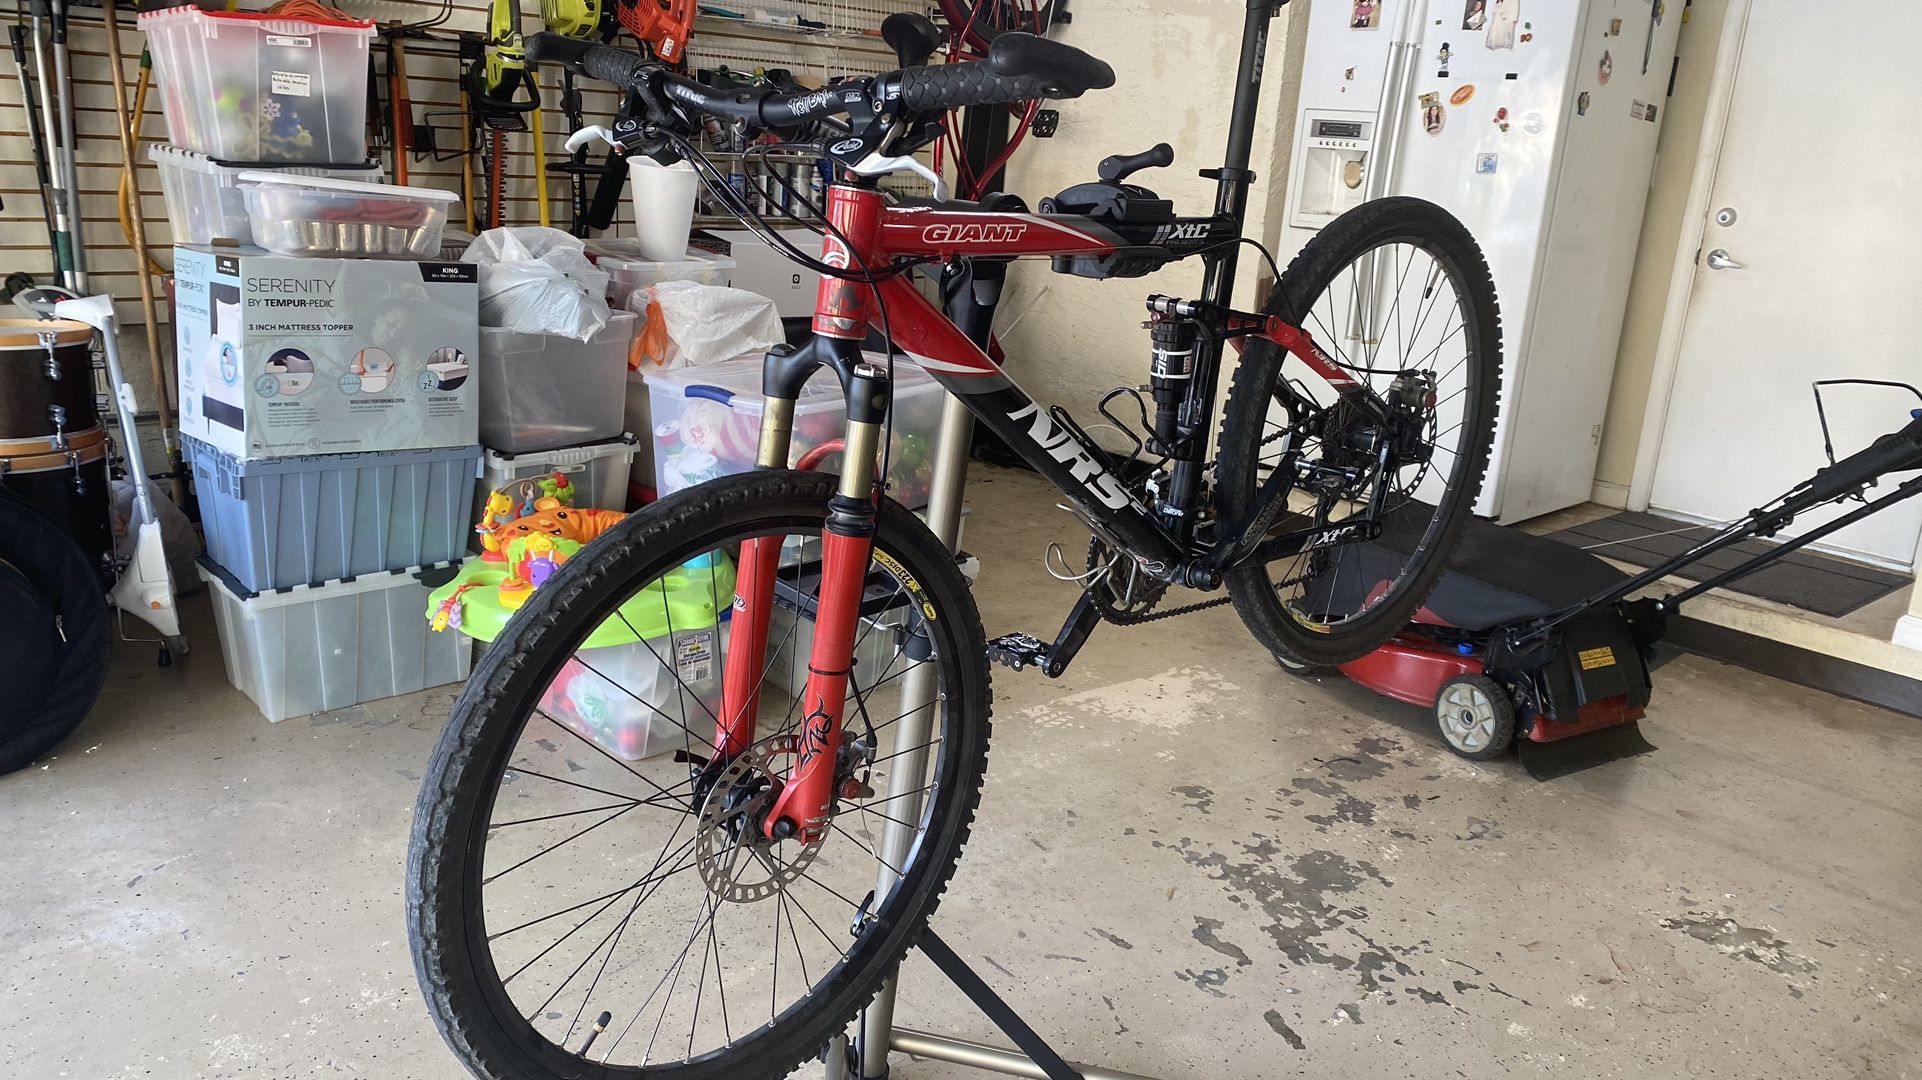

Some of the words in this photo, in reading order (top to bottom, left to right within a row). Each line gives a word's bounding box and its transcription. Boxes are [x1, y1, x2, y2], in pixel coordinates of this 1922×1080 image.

[922, 224, 1027, 244] GIANT
[247, 277, 336, 293] SERENITY
[248, 298, 262, 307] BY
[264, 298, 334, 308] TEMPUR-PEDIC
[1006, 401, 1130, 510] NRS
